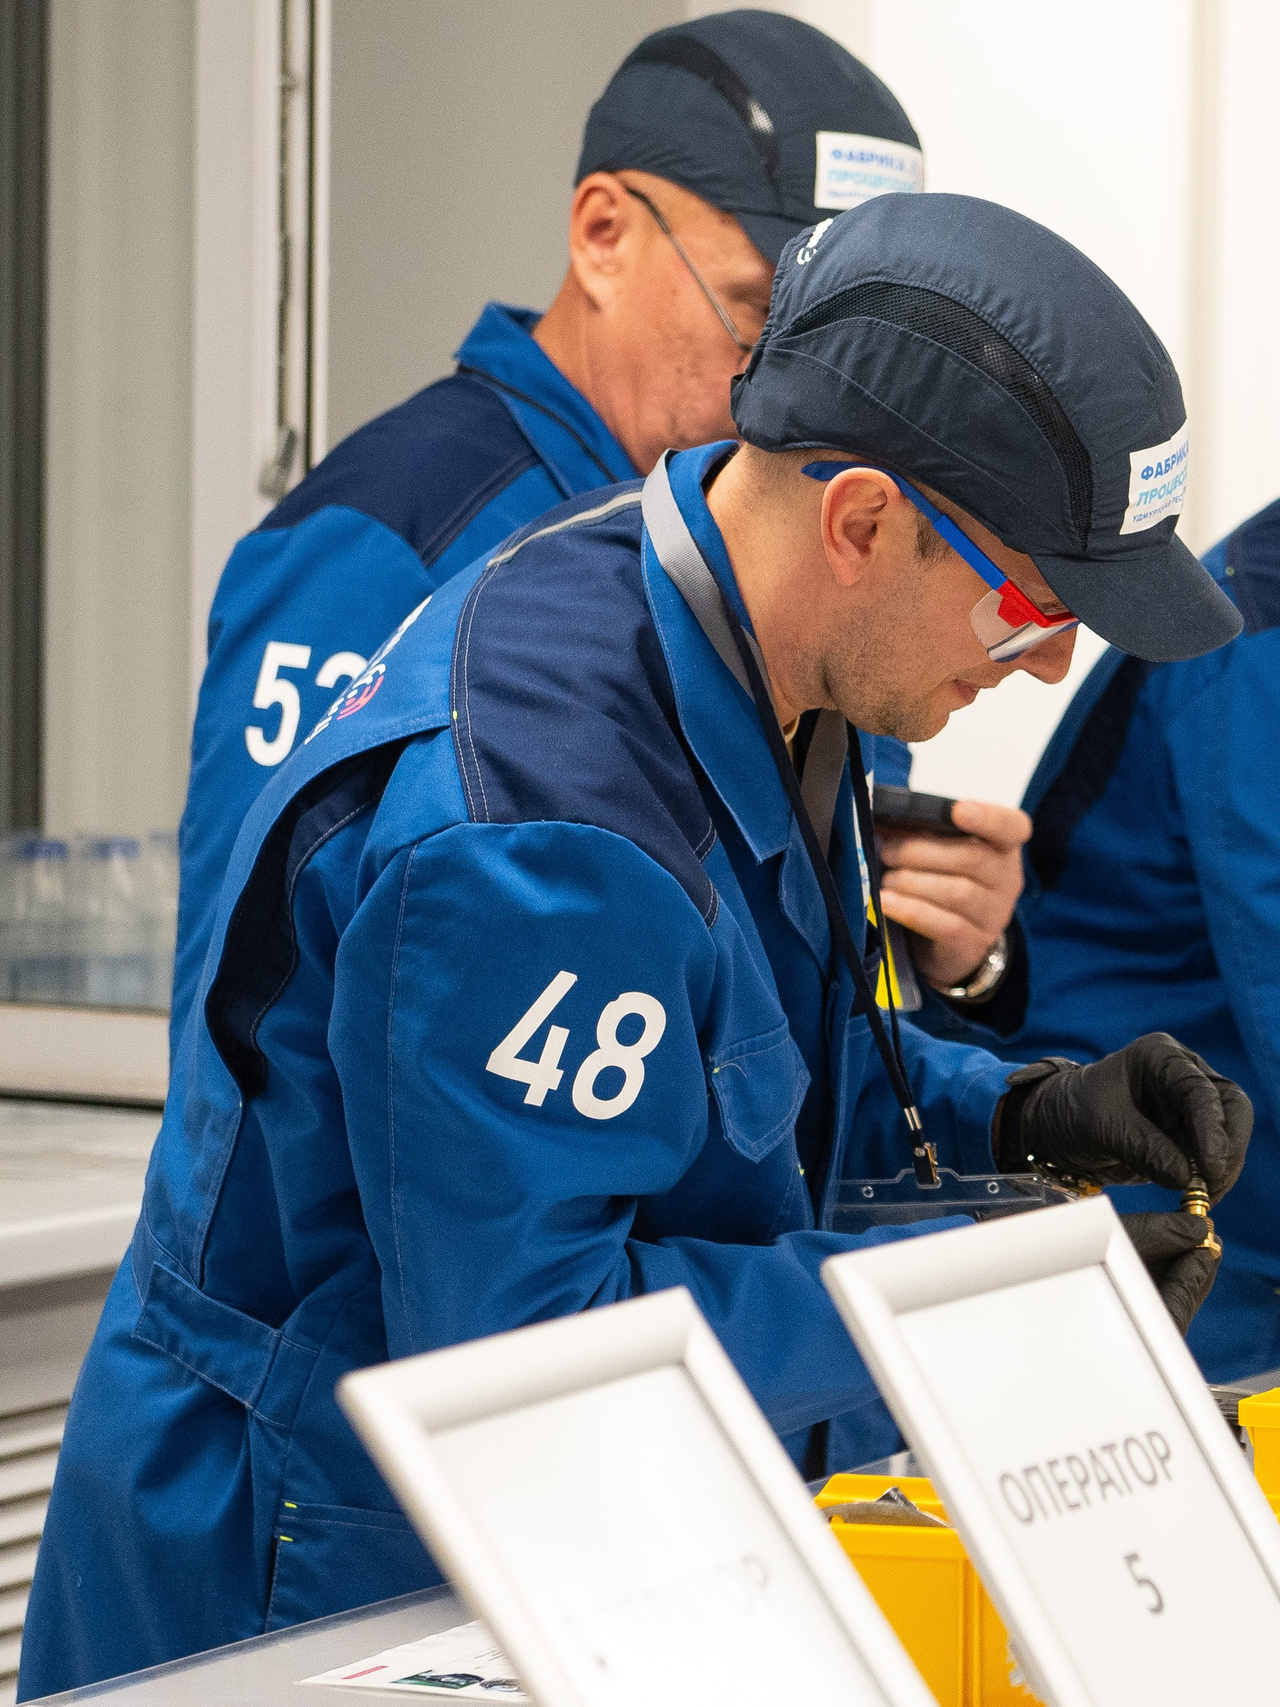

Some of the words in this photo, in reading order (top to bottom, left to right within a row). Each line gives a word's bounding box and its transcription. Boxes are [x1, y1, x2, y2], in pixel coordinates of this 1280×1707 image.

[485, 970, 667, 1120] 48
[999, 1430, 1174, 1526] ОПЕРАТОР
[1123, 1552, 1165, 1616] 5
